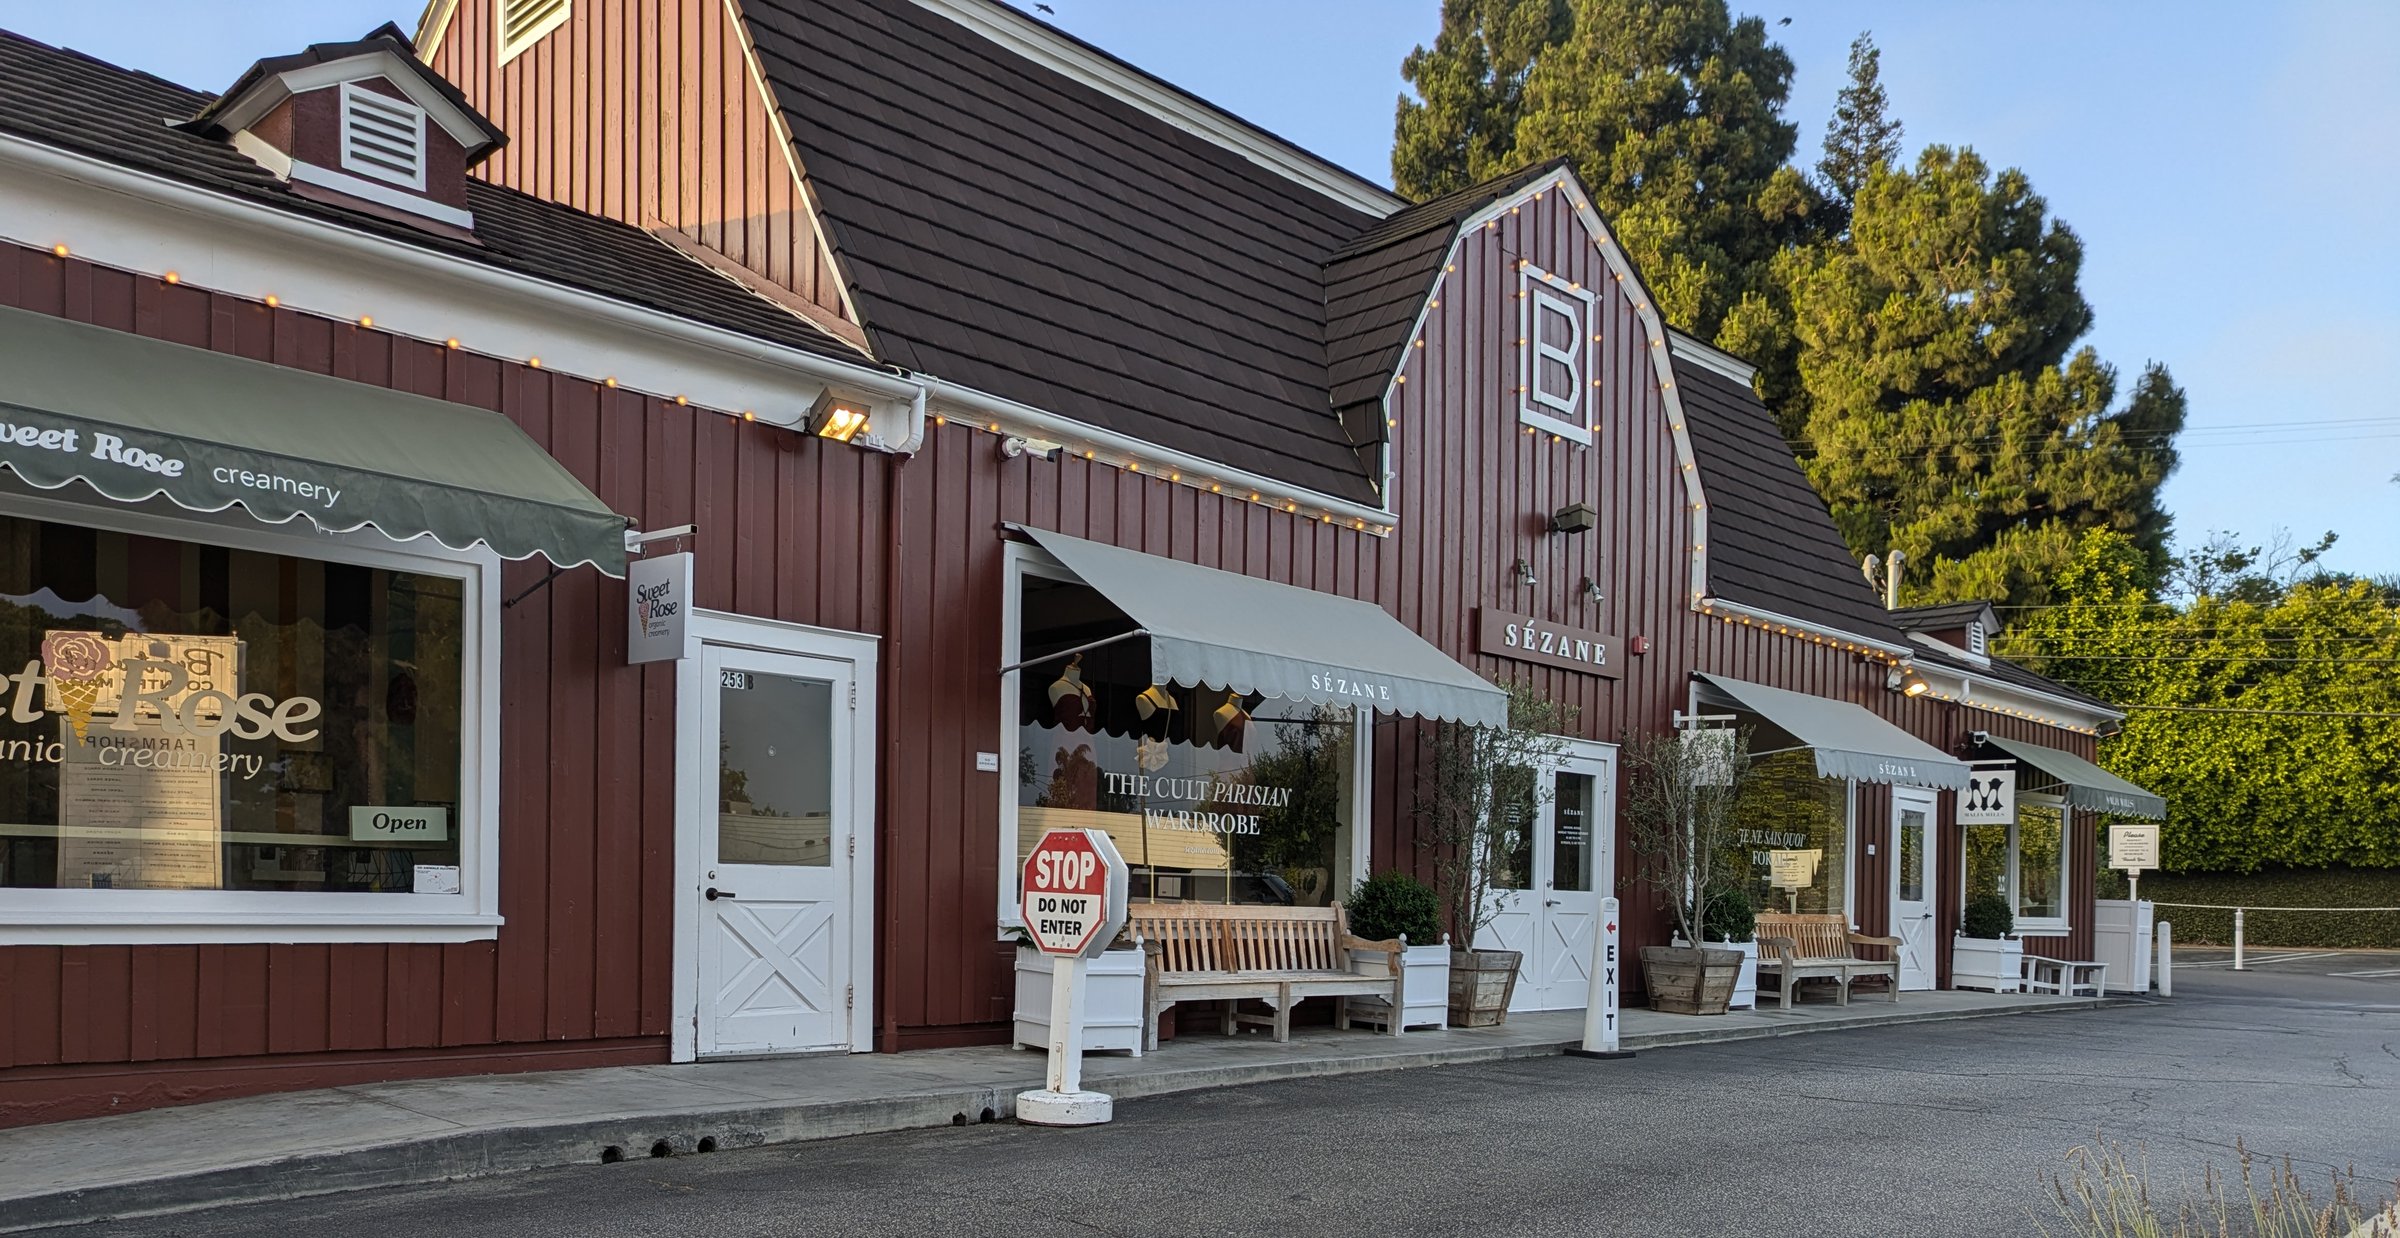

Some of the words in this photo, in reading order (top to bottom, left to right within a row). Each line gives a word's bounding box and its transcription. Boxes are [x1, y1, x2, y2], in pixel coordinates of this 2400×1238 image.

[90, 432, 185, 478] Rose
[213, 464, 341, 508] creamery
[637, 578, 671, 604] Sweet
[649, 599, 678, 619] Rose
[1505, 620, 1606, 665] SÉZANE
[722, 671, 744, 688] 253
[1311, 671, 1390, 700] SÉZANE
[110, 658, 322, 743] Rose
[99, 744, 264, 781] creamery
[1878, 760, 1917, 777] SÉZANE
[1104, 772, 1151, 797] THE
[1155, 776, 1210, 801] CULT
[1213, 782, 1293, 807] PARISIAN
[372, 812, 428, 833] Open
[1144, 807, 1261, 835] WARDROBE
[1750, 829, 1763, 844] NE
[1764, 830, 1782, 846] SAIS
[1035, 850, 1096, 890] STOP
[1038, 897, 1057, 912] DO
[1061, 899, 1087, 914] NOT
[1040, 919, 1082, 936] ENTER
[1605, 945, 1615, 1031] EXIT
